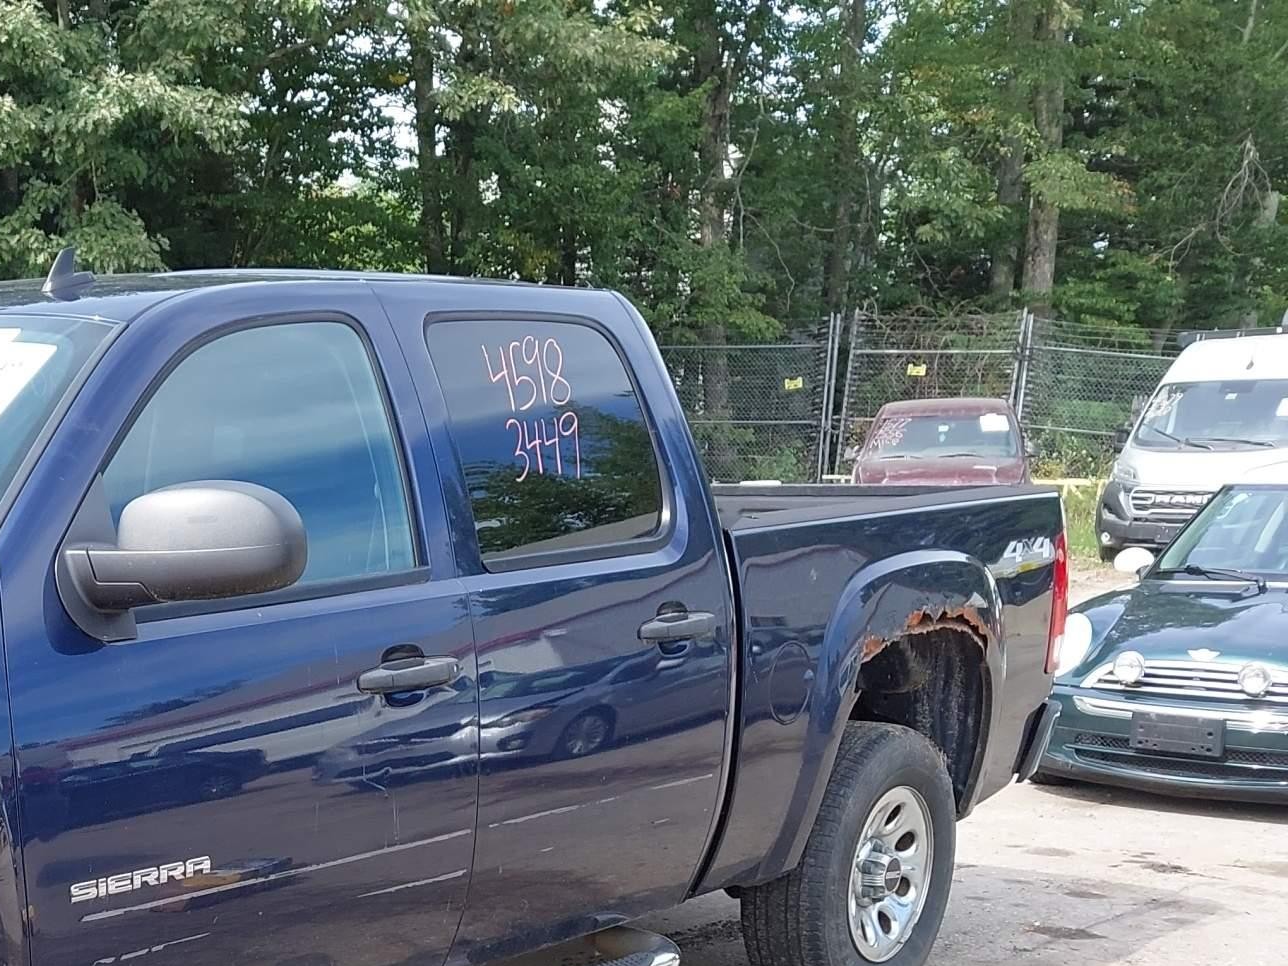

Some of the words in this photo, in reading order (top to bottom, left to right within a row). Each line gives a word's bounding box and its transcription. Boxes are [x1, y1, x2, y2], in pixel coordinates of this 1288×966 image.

[481, 335, 571, 412] 4598
[506, 411, 581, 482] 3449
[70, 855, 211, 904] SIERRA
